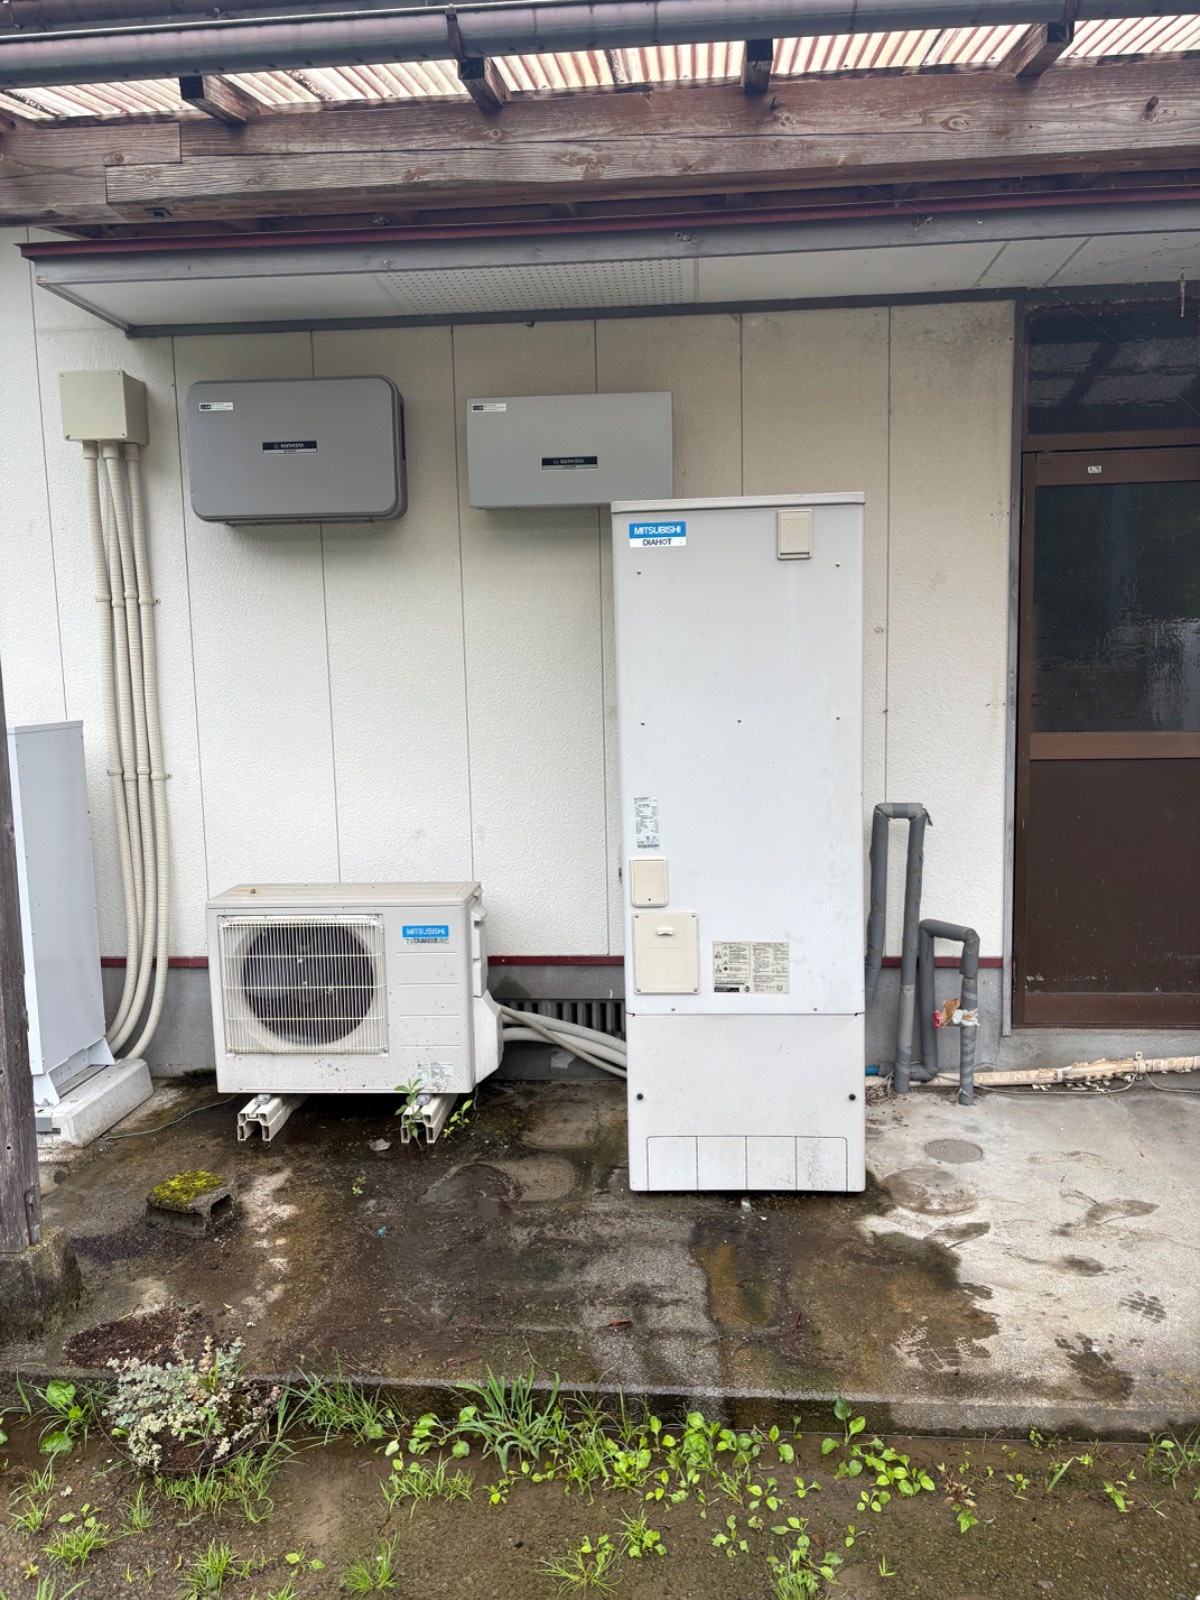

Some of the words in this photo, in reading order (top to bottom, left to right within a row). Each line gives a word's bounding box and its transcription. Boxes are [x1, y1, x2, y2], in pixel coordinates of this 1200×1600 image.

[633, 525, 681, 535] MITSUBISHI
[642, 538, 672, 546] DIAHOT
[406, 927, 446, 935] MITSUBISHI
